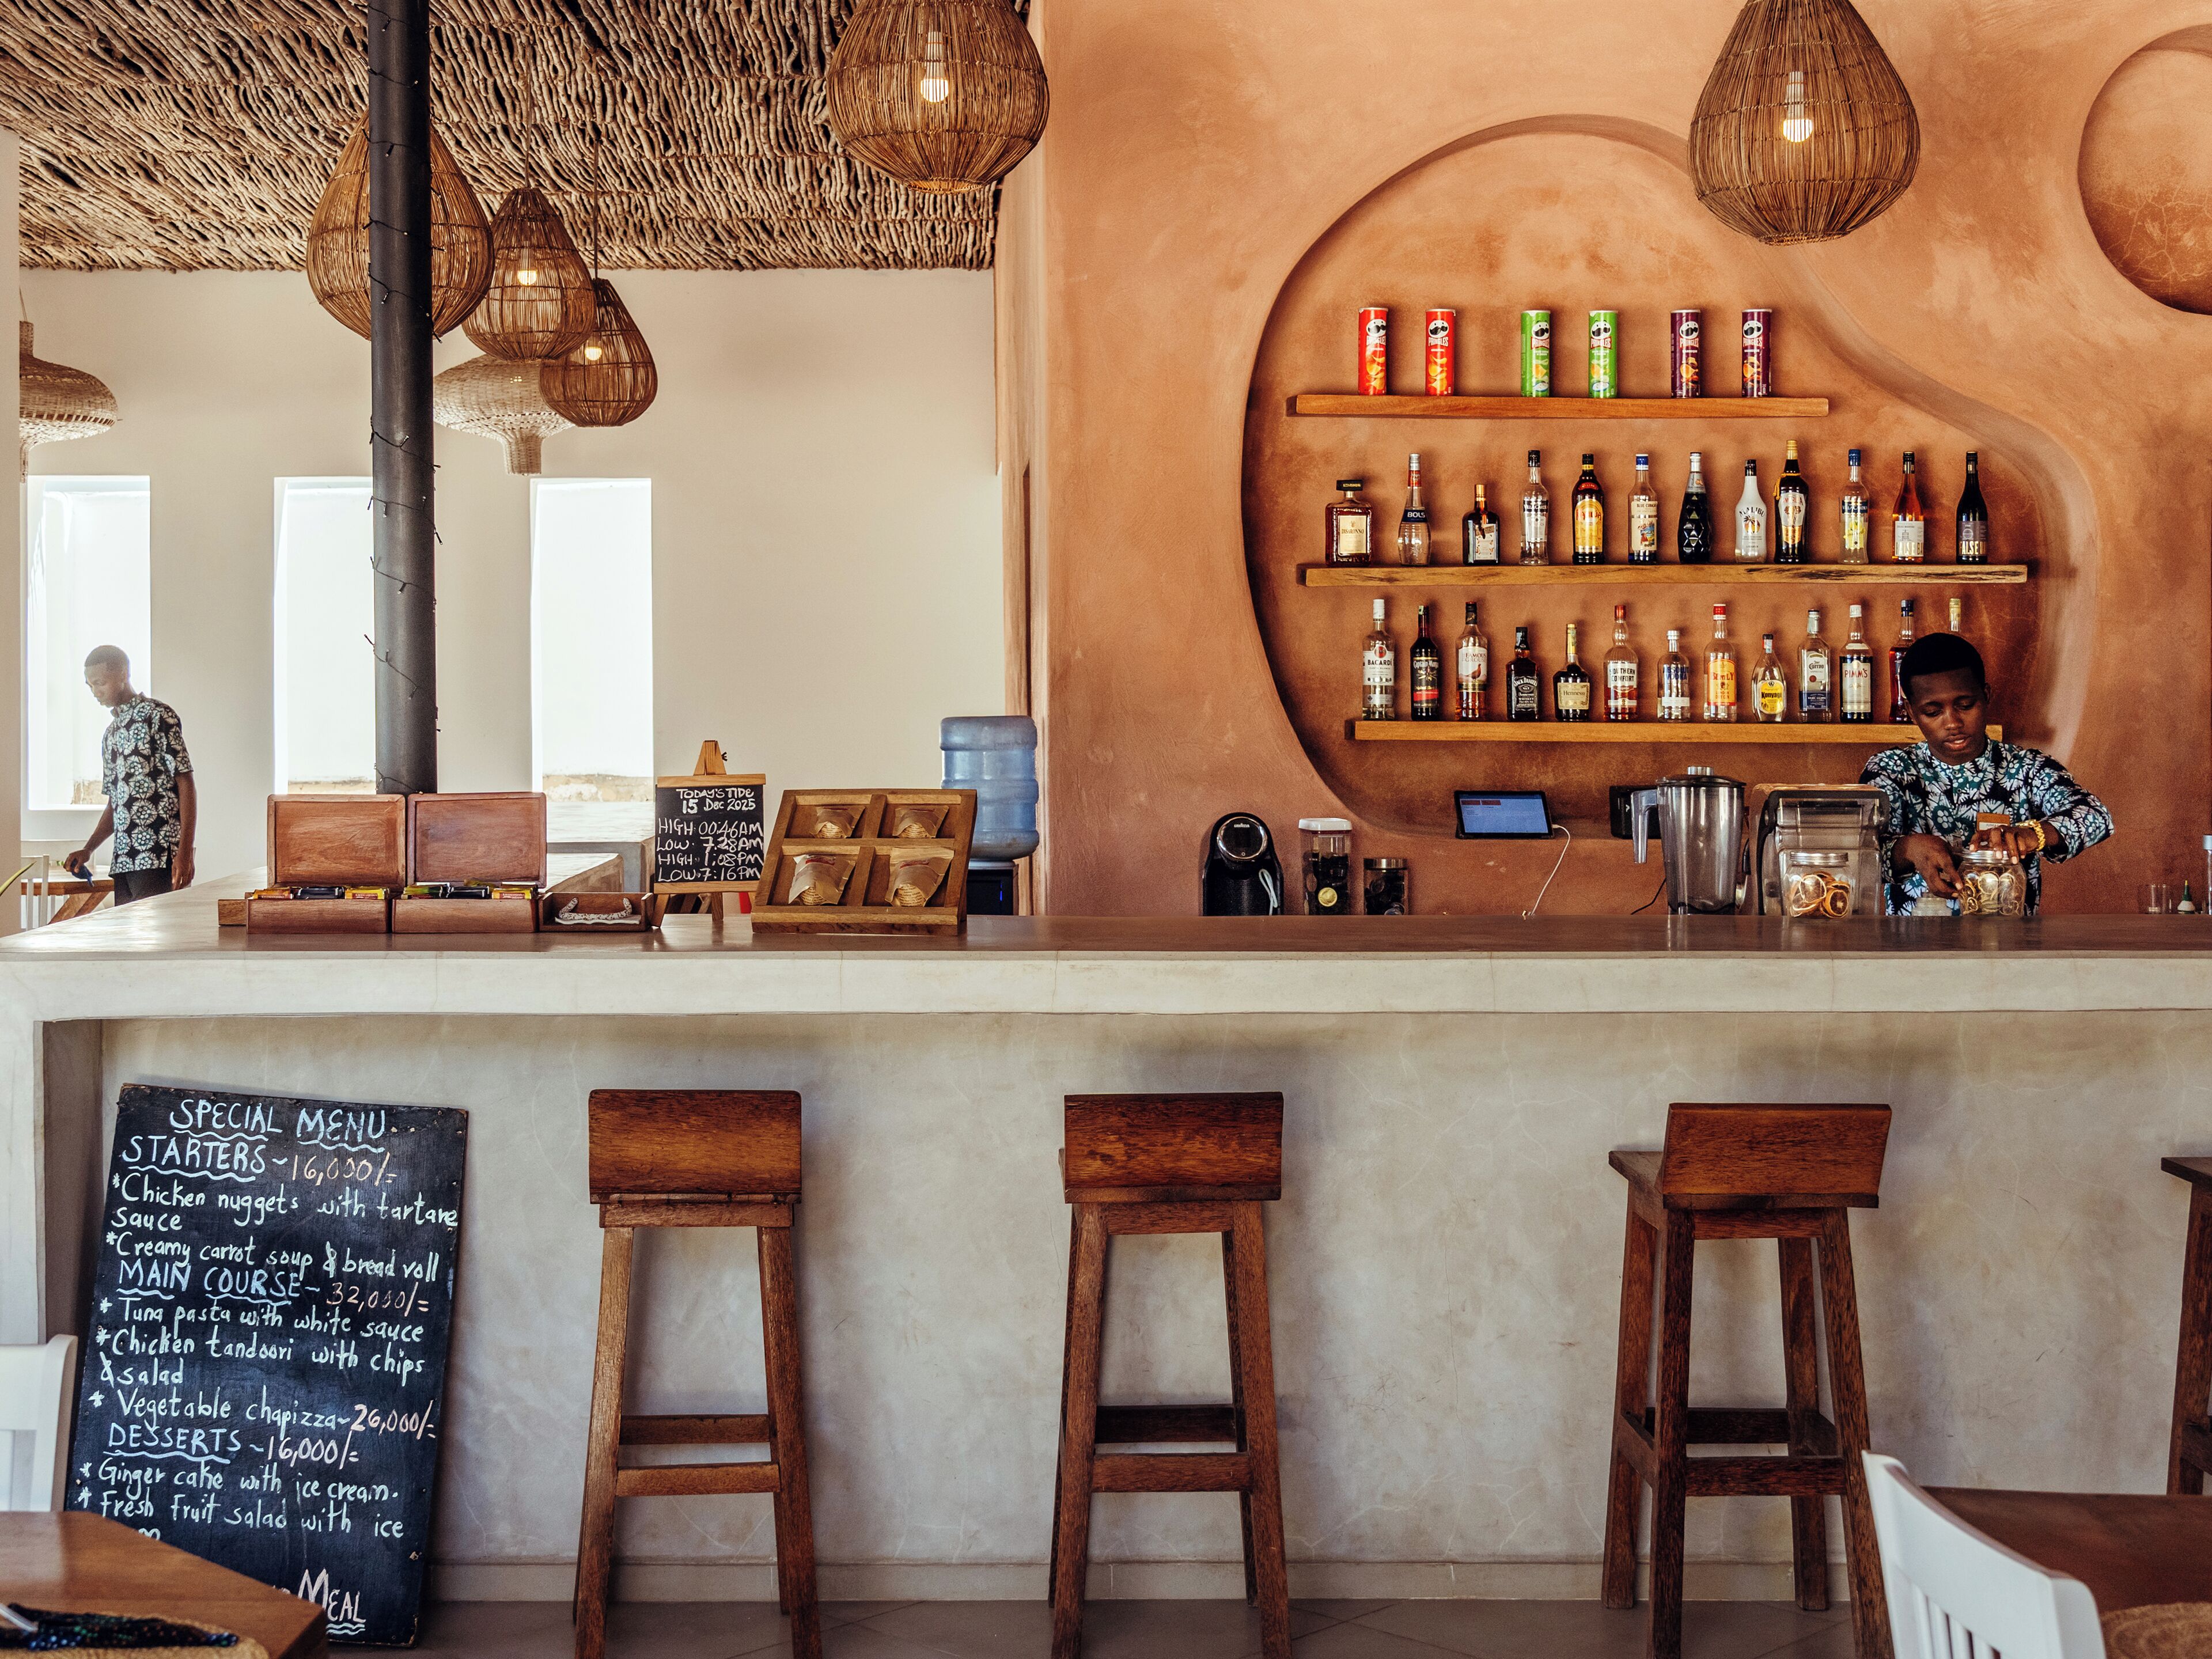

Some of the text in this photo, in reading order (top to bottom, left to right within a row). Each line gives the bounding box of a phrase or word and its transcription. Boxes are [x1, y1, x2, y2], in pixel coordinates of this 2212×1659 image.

[1366, 335, 1386, 346] PRINGLE
[1429, 336, 1448, 347] PRINGLES
[1532, 337, 1550, 349] PRINGLE
[1590, 338, 1611, 348] PRINGLES
[1680, 338, 1699, 347] PRINGLES
[1743, 337, 1763, 347] PRINGLES
[1738, 506, 1765, 517] MALIBU
[1960, 541, 1978, 555] FALSE
[1844, 668, 1868, 678] PIMM'S
[1514, 679, 1524, 687] JACK
[1761, 691, 1782, 699] Konyagi
[676, 787, 755, 800] TODAY'S TIDE
[682, 798, 698, 814] 15
[727, 798, 756, 811] 2025
[170, 1099, 385, 1142] SPECIAL MENU
[218, 1183, 298, 1226] nuggets
[317, 1187, 366, 1218] with
[376, 1191, 458, 1226] tartare
[199, 1235, 256, 1266] carrot
[266, 1250, 313, 1282] soup
[342, 1247, 396, 1277] bread
[403, 1251, 440, 1282] roll
[119, 1258, 192, 1291] MAIN
[204, 1267, 301, 1297] COURSE
[118, 1297, 424, 1342] Tuna pasta with white sauce
[205, 1324, 294, 1360] tandoori
[312, 1339, 358, 1370] with
[370, 1341, 425, 1387] chips
[116, 1357, 184, 1386] salad
[117, 1386, 231, 1431] Vegetable
[108, 1422, 241, 1455] DESSERTS
[98, 1457, 166, 1501] Ginger
[173, 1459, 224, 1490] cake
[240, 1462, 282, 1494] with
[296, 1472, 321, 1502] ice
[224, 1498, 287, 1529] salad
[301, 1499, 351, 1533] with
[374, 1513, 404, 1539] ice
[297, 1567, 367, 1623] MEAL
